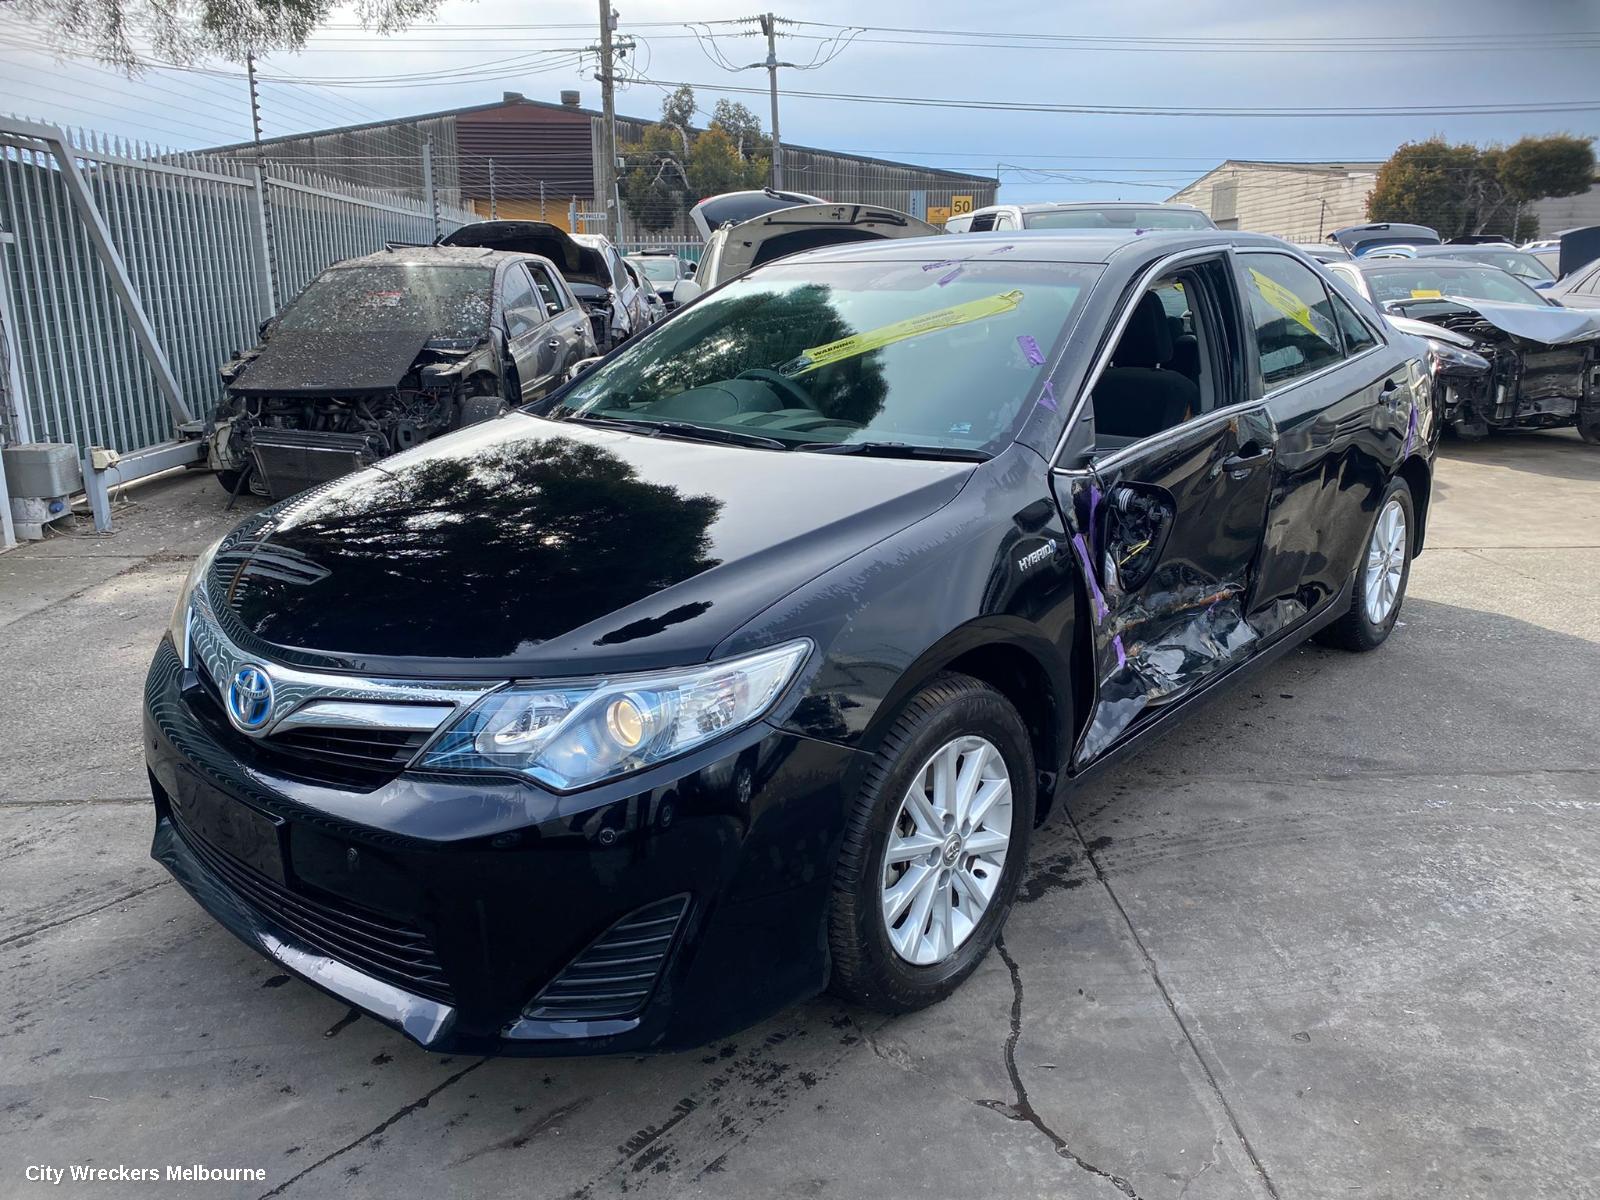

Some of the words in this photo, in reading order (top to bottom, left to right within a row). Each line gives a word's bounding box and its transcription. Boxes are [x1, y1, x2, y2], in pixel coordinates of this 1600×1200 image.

[954, 200, 970, 213] 50
[813, 339, 855, 356] WARNING
[1018, 544, 1051, 572] HYBRID
